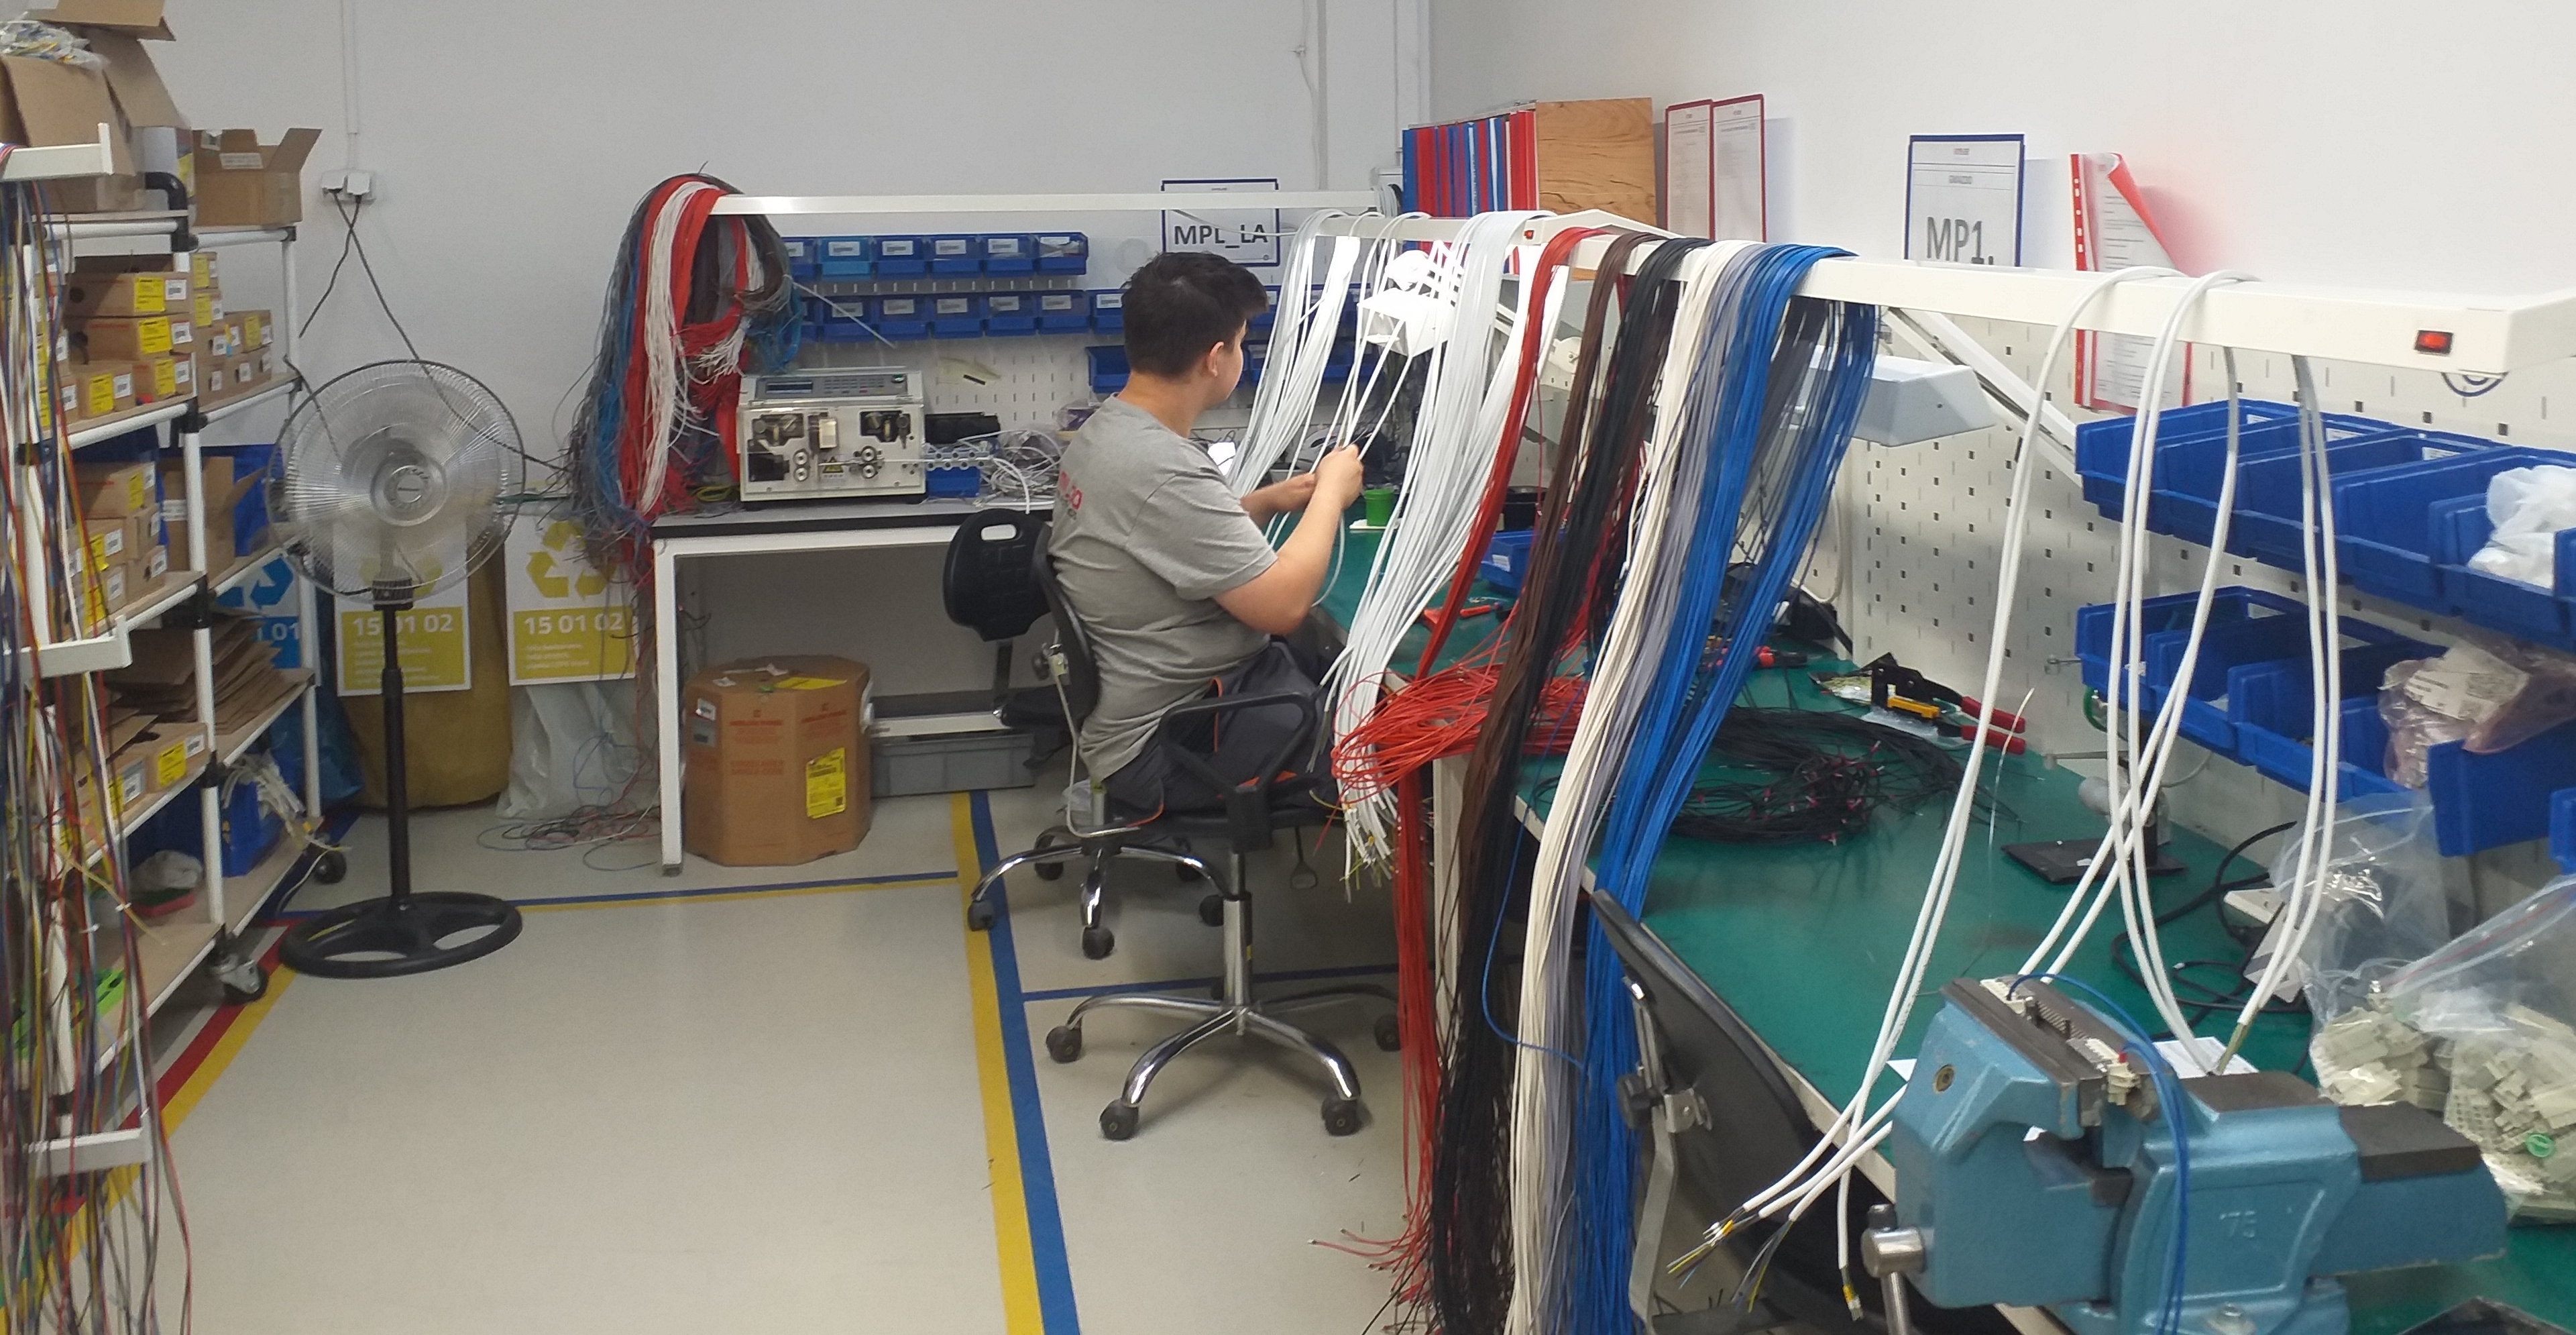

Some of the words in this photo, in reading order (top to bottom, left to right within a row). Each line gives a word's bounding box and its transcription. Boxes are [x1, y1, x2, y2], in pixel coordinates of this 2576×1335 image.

[1174, 224, 1268, 249] MPL_LA
[353, 616, 382, 636] 15
[424, 614, 453, 633] 02
[524, 617, 552, 635] 15
[559, 615, 587, 633] 01
[594, 612, 623, 631] 02
